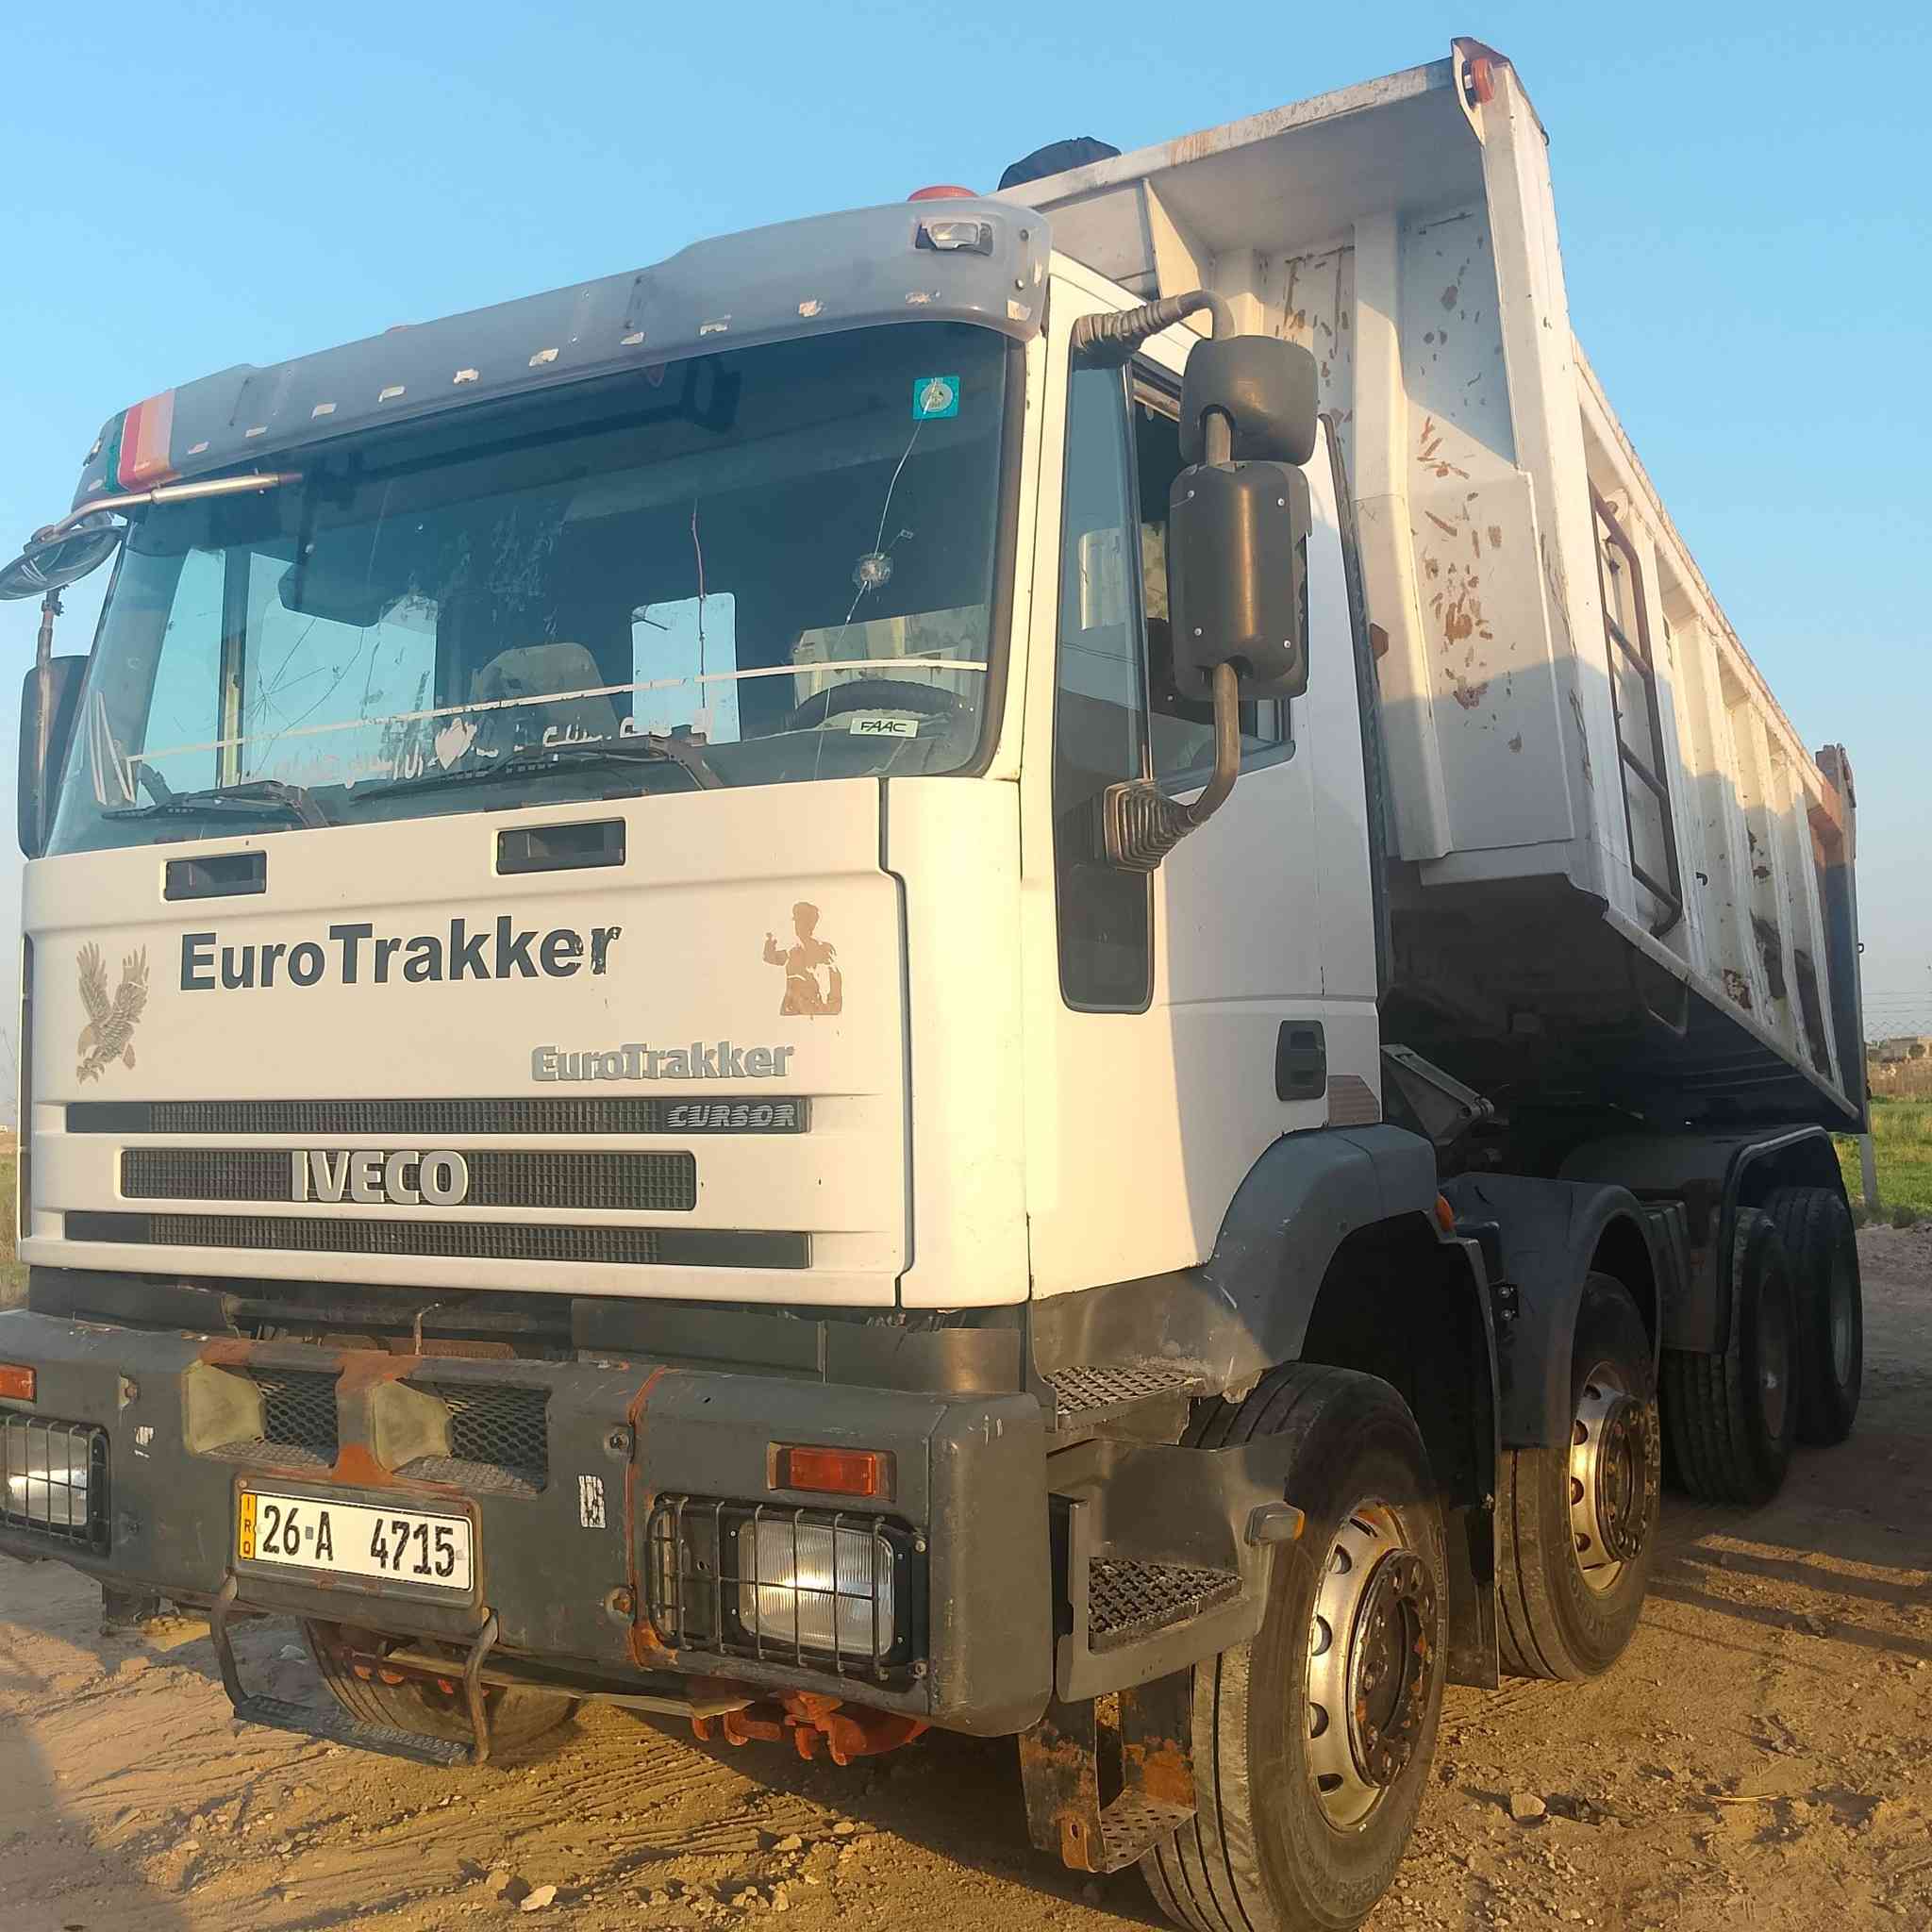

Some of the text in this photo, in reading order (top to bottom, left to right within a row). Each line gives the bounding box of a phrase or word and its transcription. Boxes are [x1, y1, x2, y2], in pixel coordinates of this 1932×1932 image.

[860, 720, 907, 733] FAAC
[180, 914, 623, 991] EuroTrakker
[531, 1041, 795, 1082] EuroTrakker
[666, 1104, 796, 1128] CURSOR
[291, 1149, 470, 1206] IVECO
[370, 1518, 456, 1578] 4715
